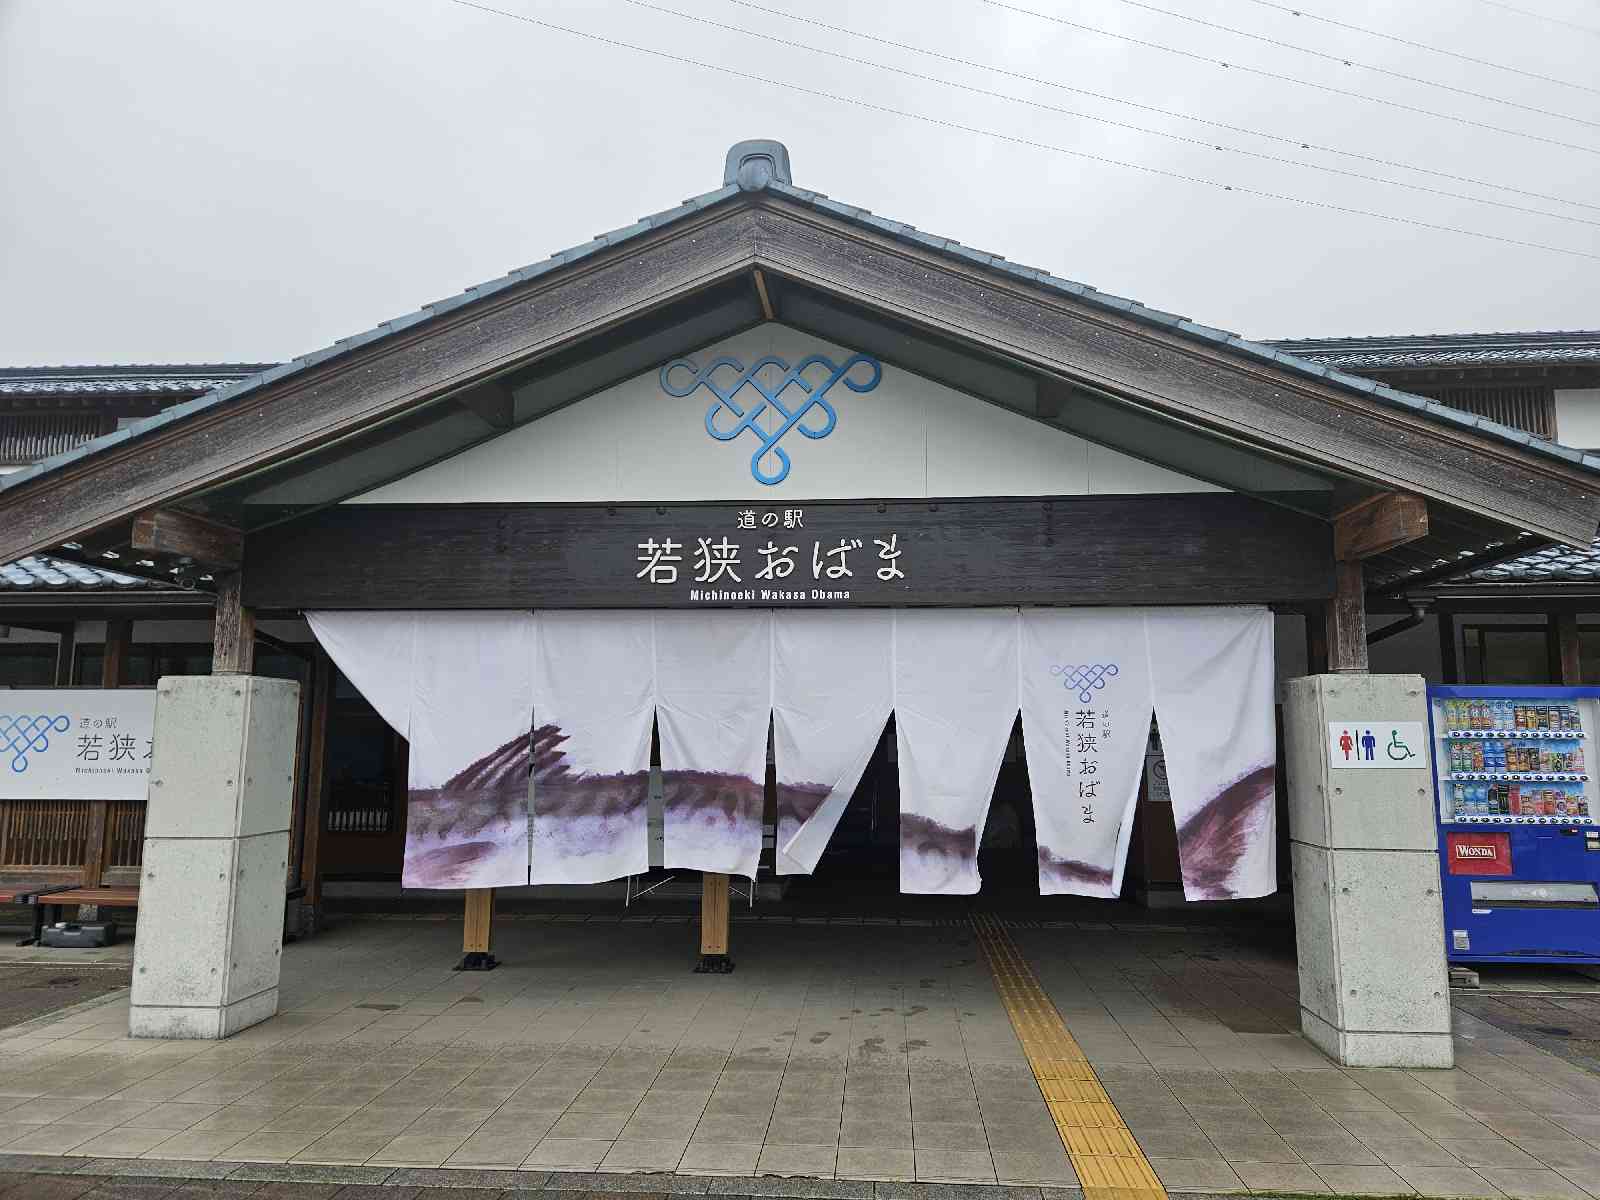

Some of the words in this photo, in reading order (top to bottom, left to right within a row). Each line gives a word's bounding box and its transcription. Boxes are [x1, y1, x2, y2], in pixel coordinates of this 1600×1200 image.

[736, 509, 804, 529] 道の駅
[636, 533, 905, 584] 若狭おばま
[690, 589, 755, 601] Michinoeki
[761, 589, 806, 601] Wakasa
[811, 589, 850, 601] Obama
[1075, 709, 1101, 824] 若狭おばま
[1458, 845, 1494, 857] WONDA
